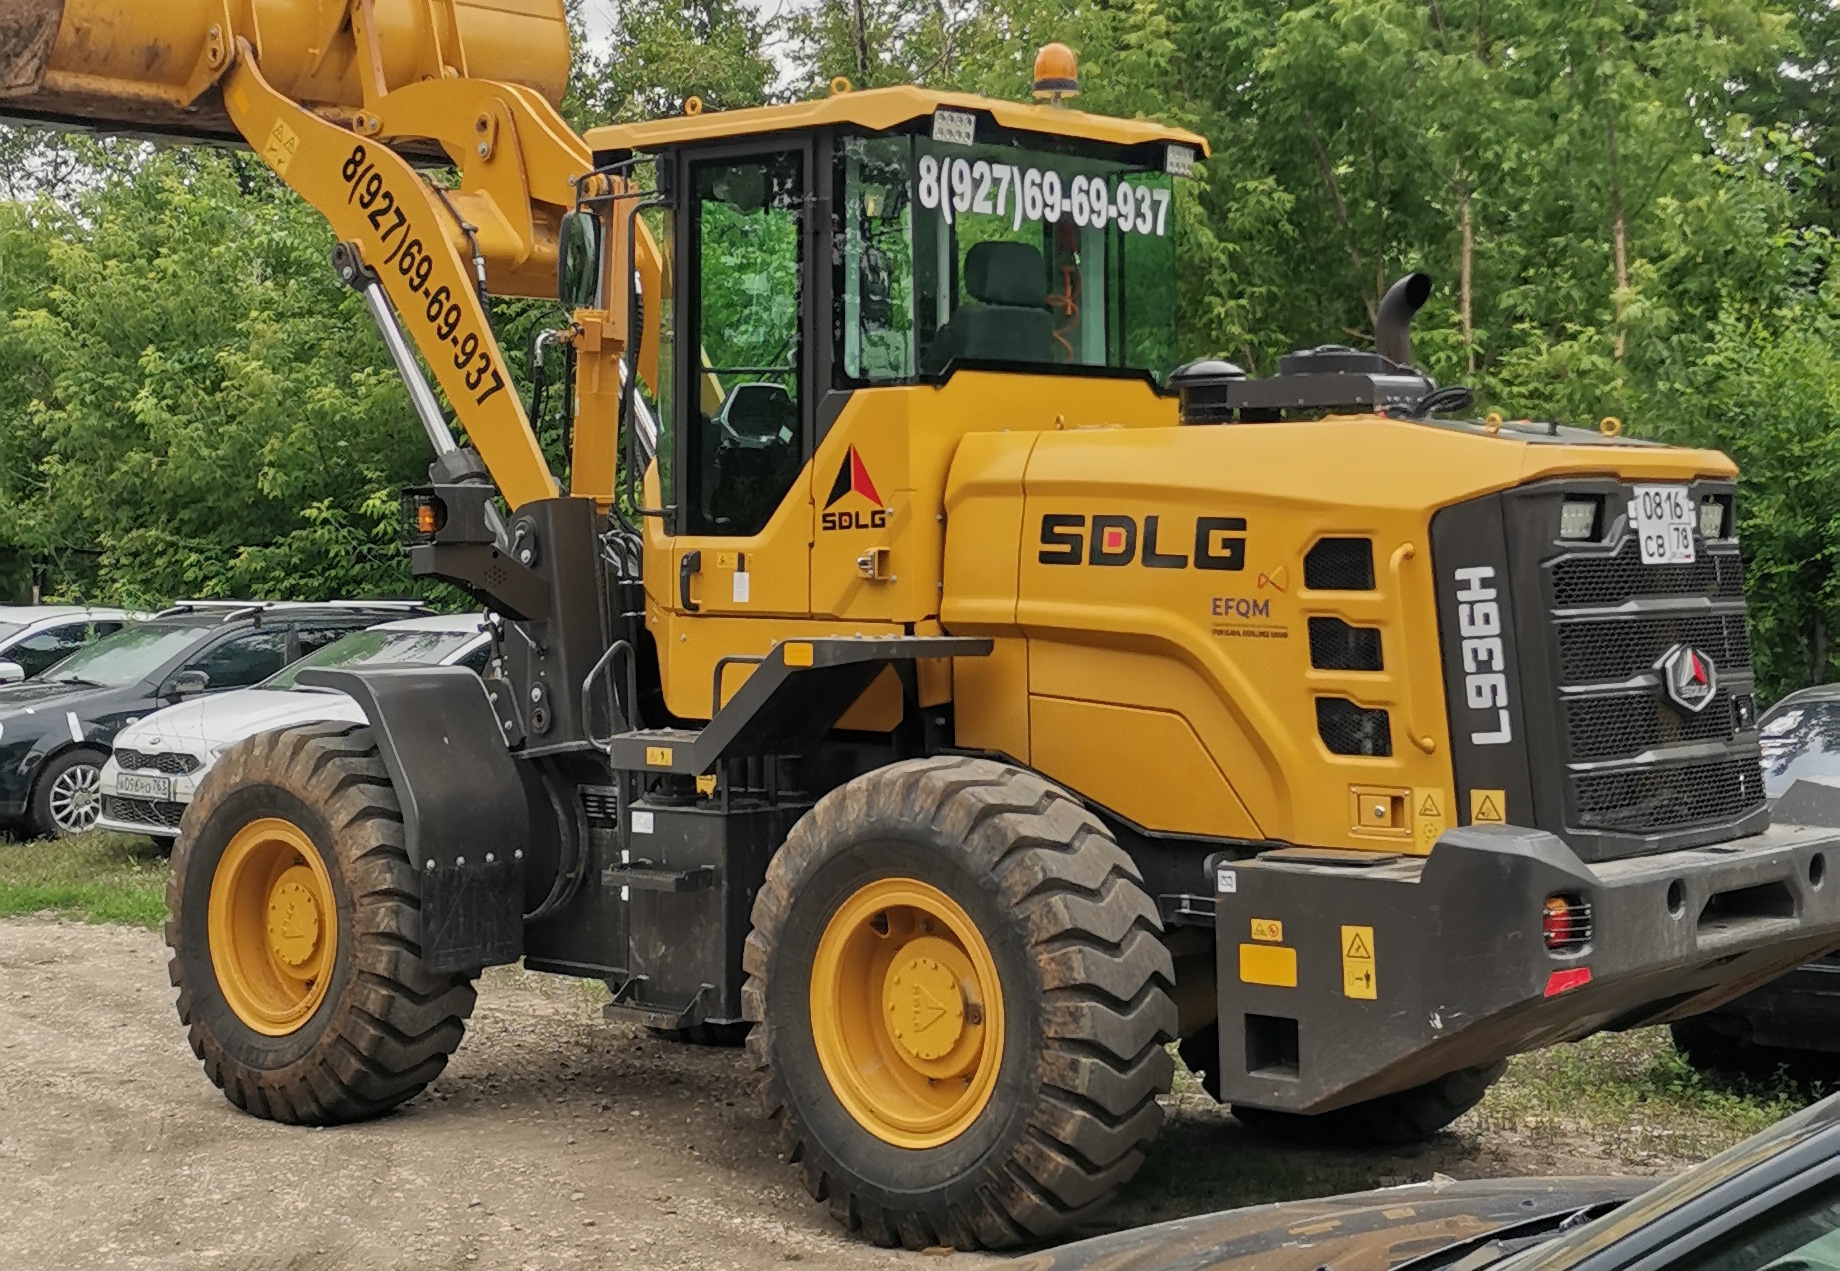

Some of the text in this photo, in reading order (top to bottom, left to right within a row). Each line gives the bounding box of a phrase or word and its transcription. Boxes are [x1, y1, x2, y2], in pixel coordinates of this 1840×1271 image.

[919, 155, 1170, 236] 8(927)69-69-937
[342, 145, 505, 406] 8(927)69-69-937
[822, 510, 886, 531] SDLG
[1643, 491, 1683, 520] 0816
[1039, 514, 1247, 571] SDLG
[1673, 527, 1689, 549] 78
[1212, 597, 1270, 619] EFQM
[1454, 566, 1512, 744] L936H
